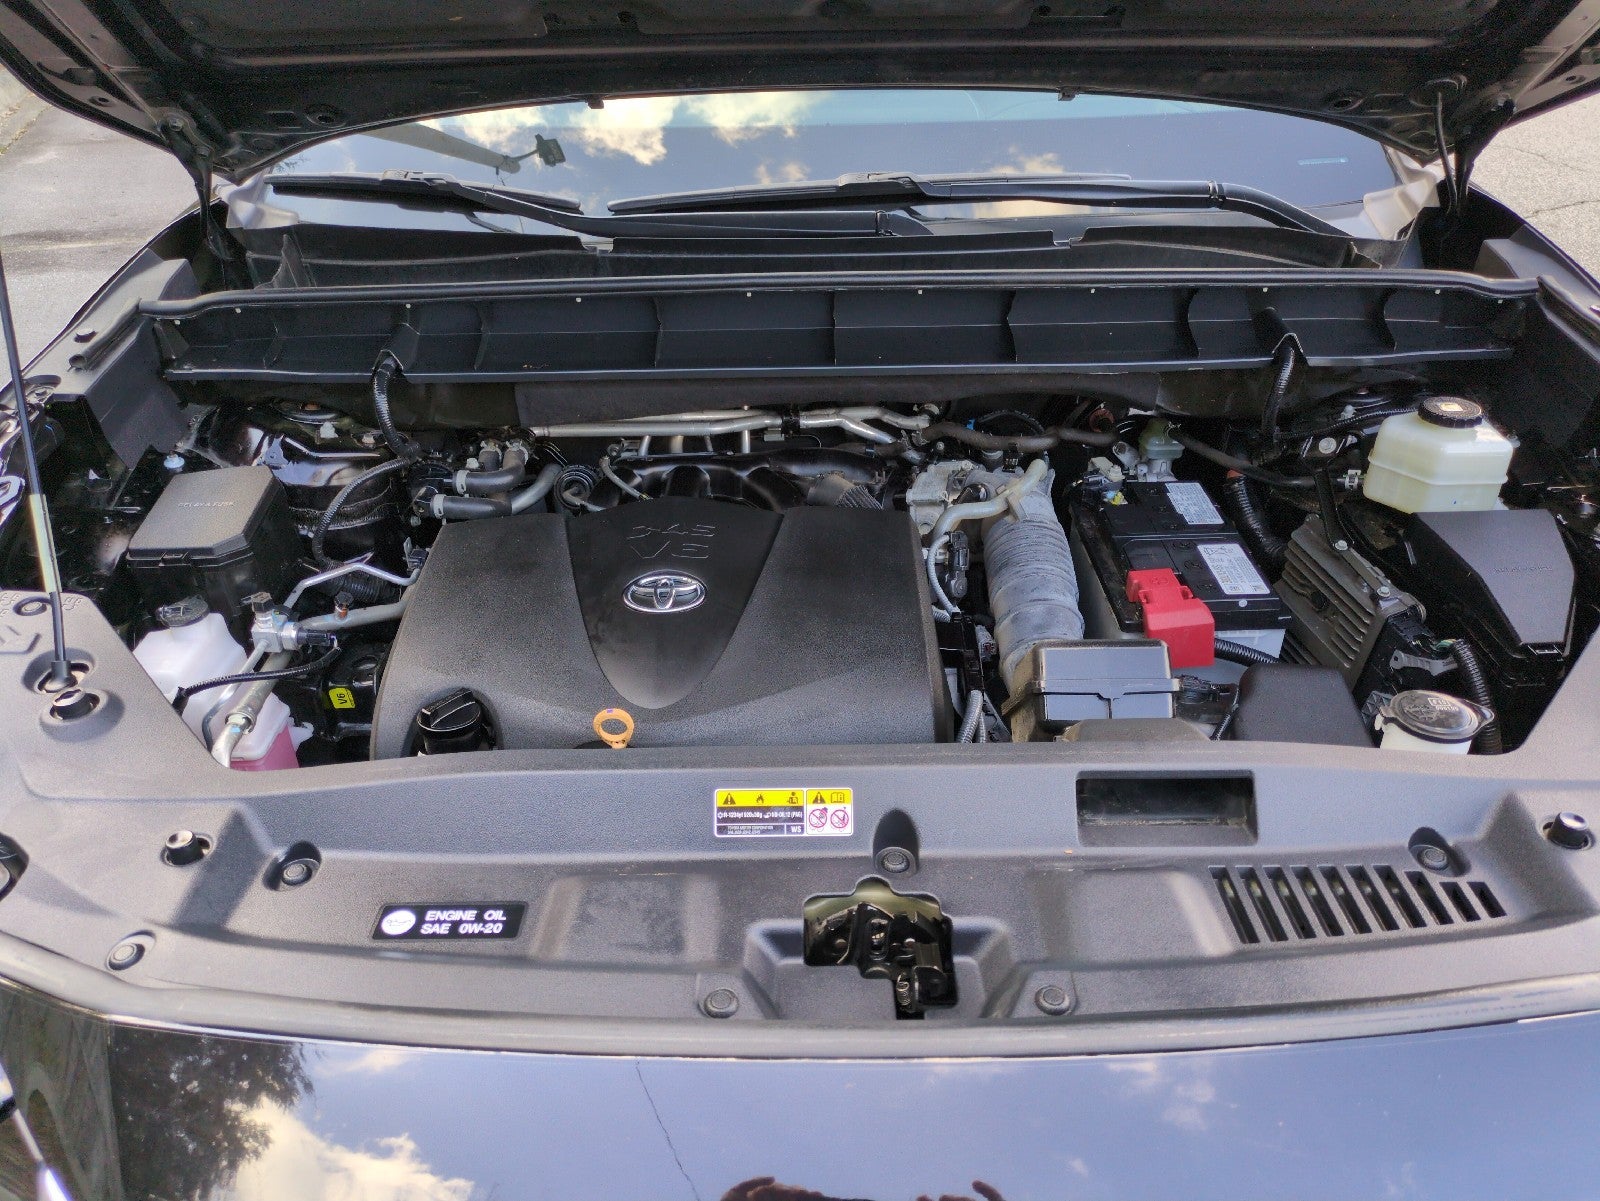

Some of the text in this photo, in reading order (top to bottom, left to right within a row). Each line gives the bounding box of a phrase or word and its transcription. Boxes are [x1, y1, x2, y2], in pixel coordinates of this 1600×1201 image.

[336, 693, 348, 705] V6
[791, 825, 802, 833] WS
[425, 910, 507, 921] ENGINE OIL
[420, 923, 503, 934] SAE 0W-20
